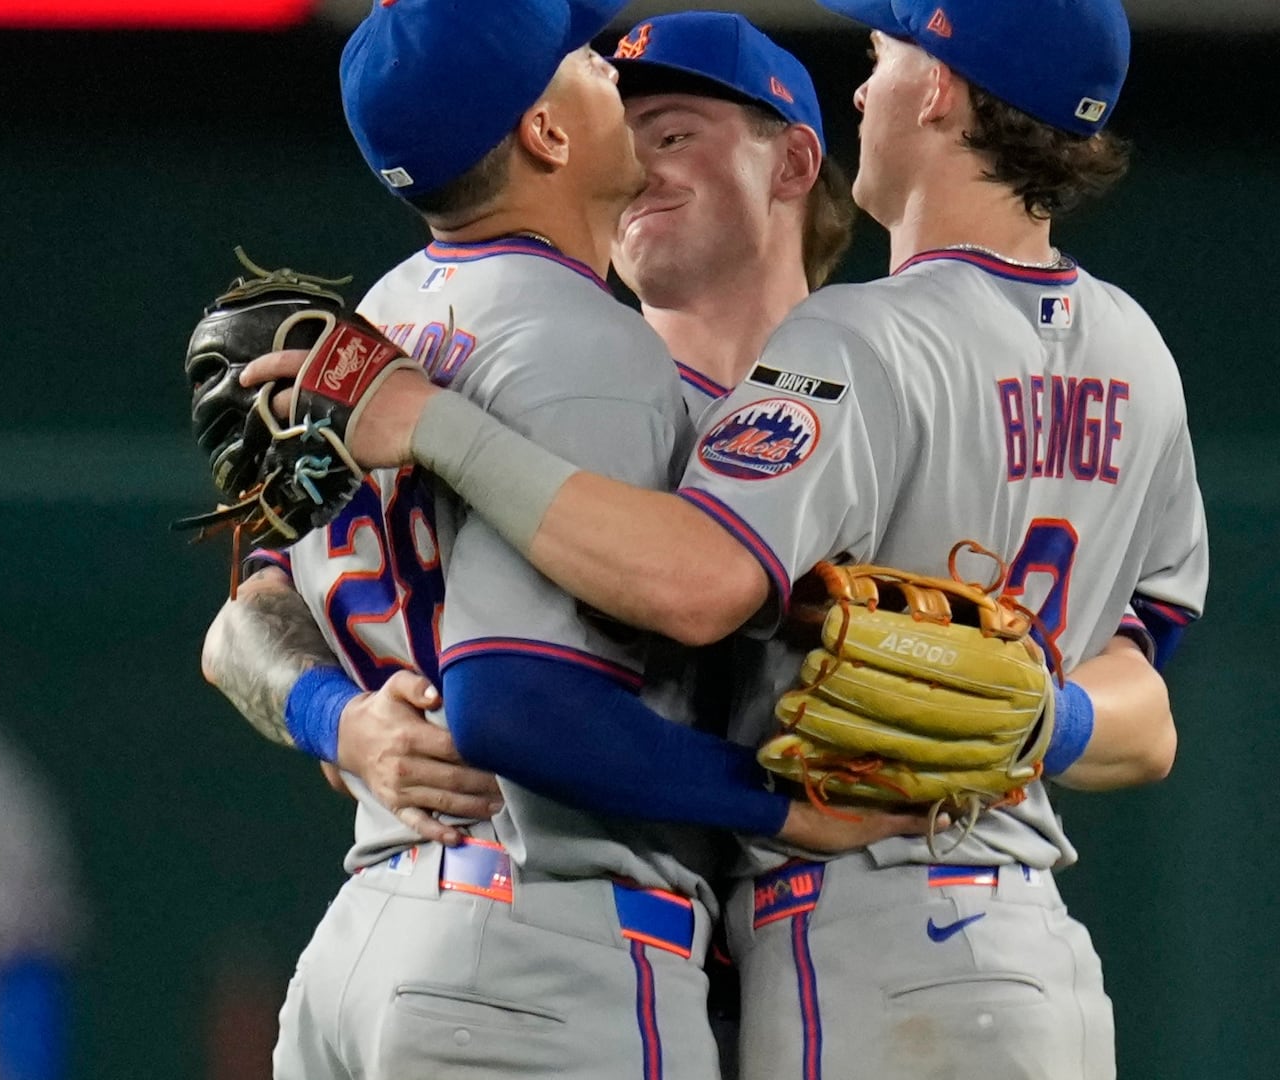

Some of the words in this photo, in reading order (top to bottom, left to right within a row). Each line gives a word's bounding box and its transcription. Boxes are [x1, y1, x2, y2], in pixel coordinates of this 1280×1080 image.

[775, 372, 821, 397] DAVEY
[712, 427, 797, 463] Mets
[997, 375, 1130, 485] BENGE
[877, 631, 959, 667] A2000
